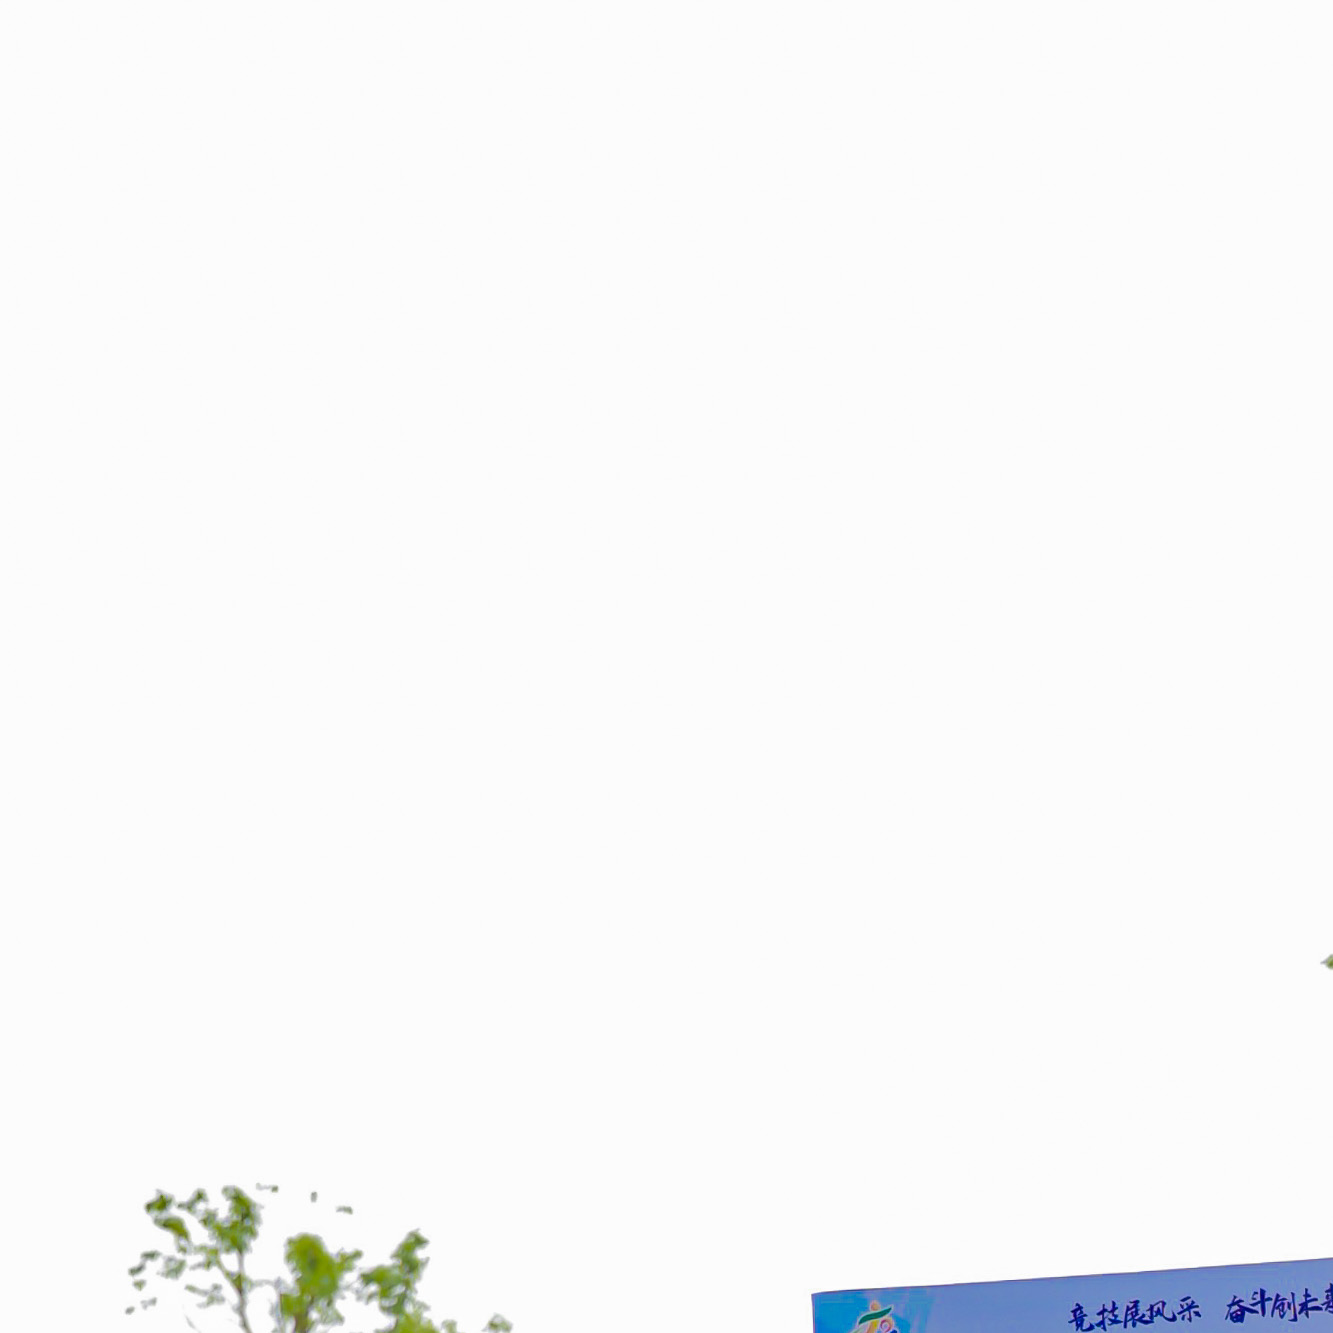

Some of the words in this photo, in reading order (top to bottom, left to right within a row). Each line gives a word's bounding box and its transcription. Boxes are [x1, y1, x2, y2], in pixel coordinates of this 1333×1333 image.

[1068, 1296, 1202, 1332] 竞技展风采
